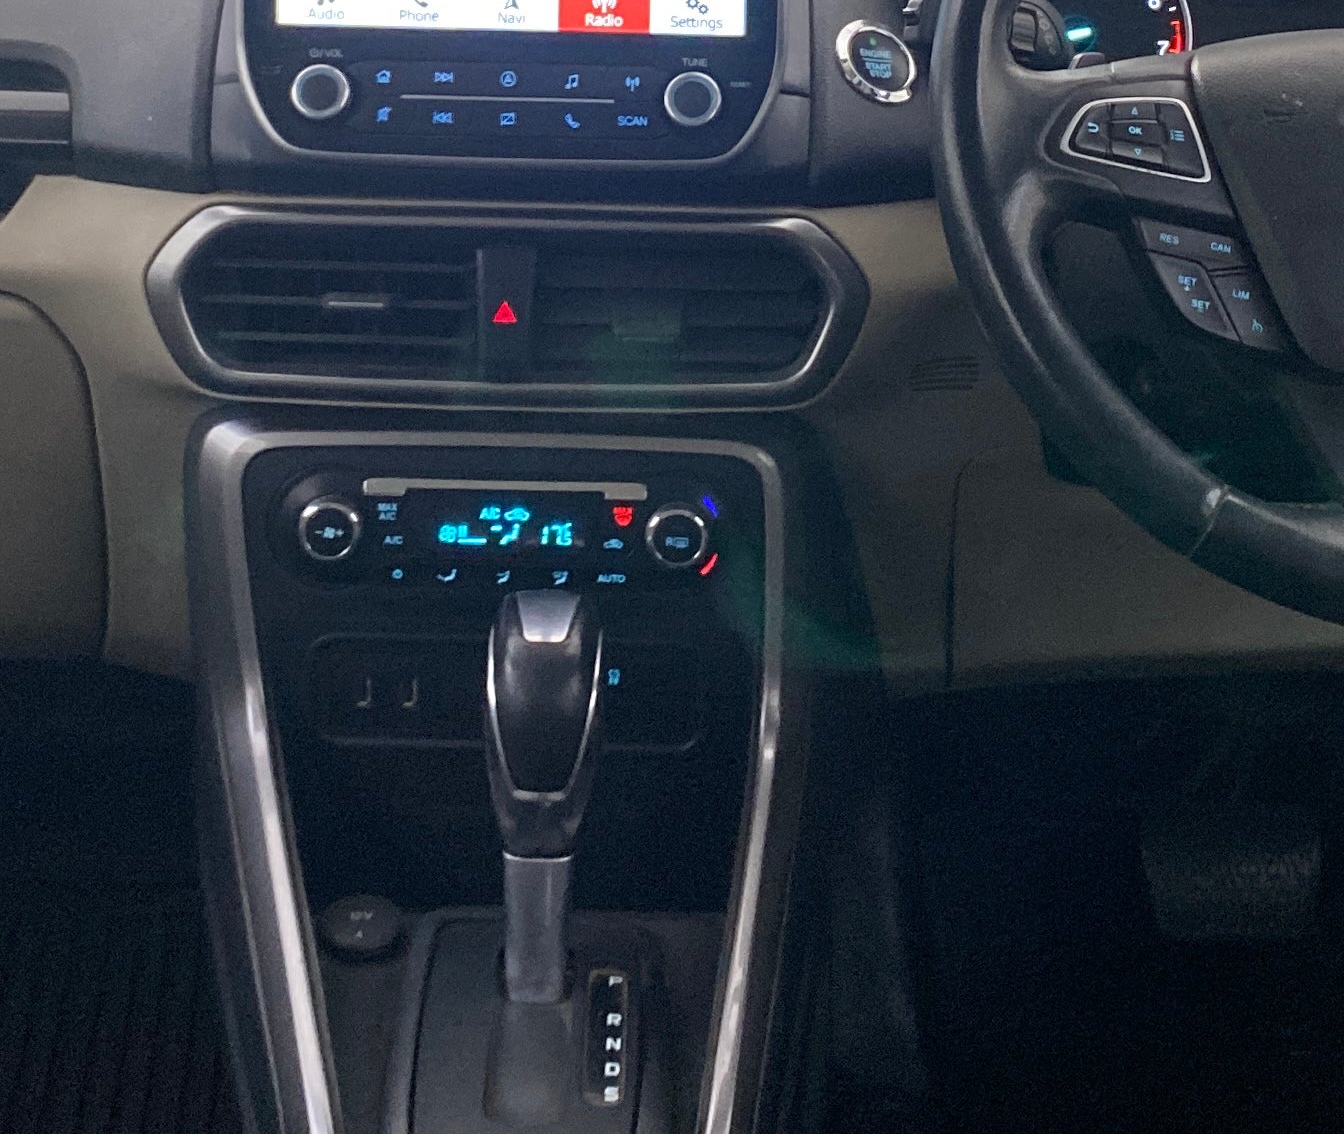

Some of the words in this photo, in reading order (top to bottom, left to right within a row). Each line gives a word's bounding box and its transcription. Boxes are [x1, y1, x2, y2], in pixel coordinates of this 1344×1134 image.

[308, 7, 345, 20] Audio
[399, 9, 440, 22] Phone
[497, 11, 526, 24] Navi
[584, 12, 624, 28] Radio
[670, 15, 723, 30] Settings
[1156, 40, 1170, 56] 7
[681, 56, 708, 68] TUNE
[617, 115, 649, 127] SCAN
[1128, 125, 1143, 136] OK
[1159, 232, 1180, 245] RES
[1210, 242, 1232, 254] CAN
[1177, 274, 1198, 287] SET
[1232, 289, 1250, 301] LIM
[1190, 298, 1211, 310] SET
[596, 573, 627, 584] AUTO
[608, 975, 624, 987] P
[606, 1012, 623, 1026] R
[605, 1037, 622, 1051] N
[603, 1061, 621, 1077] D
